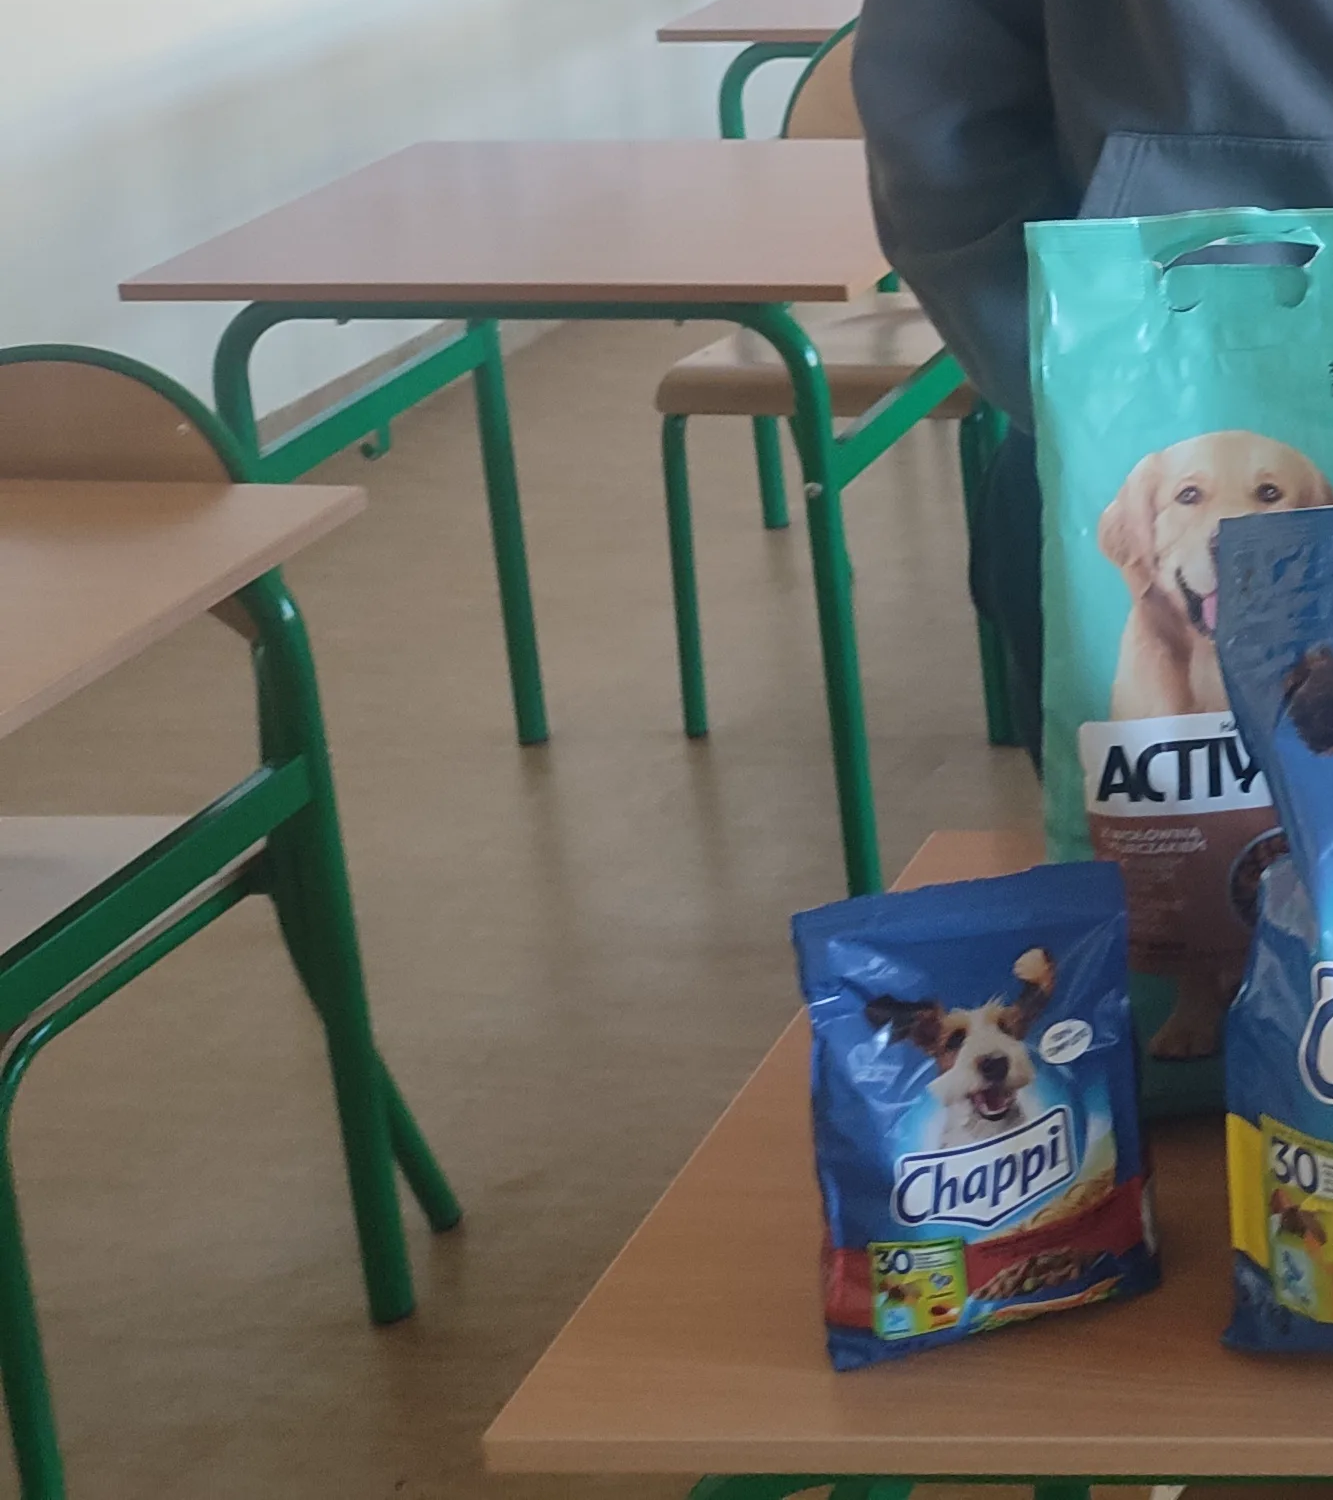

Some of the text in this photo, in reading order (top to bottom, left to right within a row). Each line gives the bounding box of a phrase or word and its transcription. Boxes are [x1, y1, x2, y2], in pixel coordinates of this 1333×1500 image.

[1095, 736, 1262, 803] ACTIV
[897, 1123, 1063, 1225] Chappi
[1270, 1135, 1319, 1195] 30
[873, 1247, 914, 1275] 30
